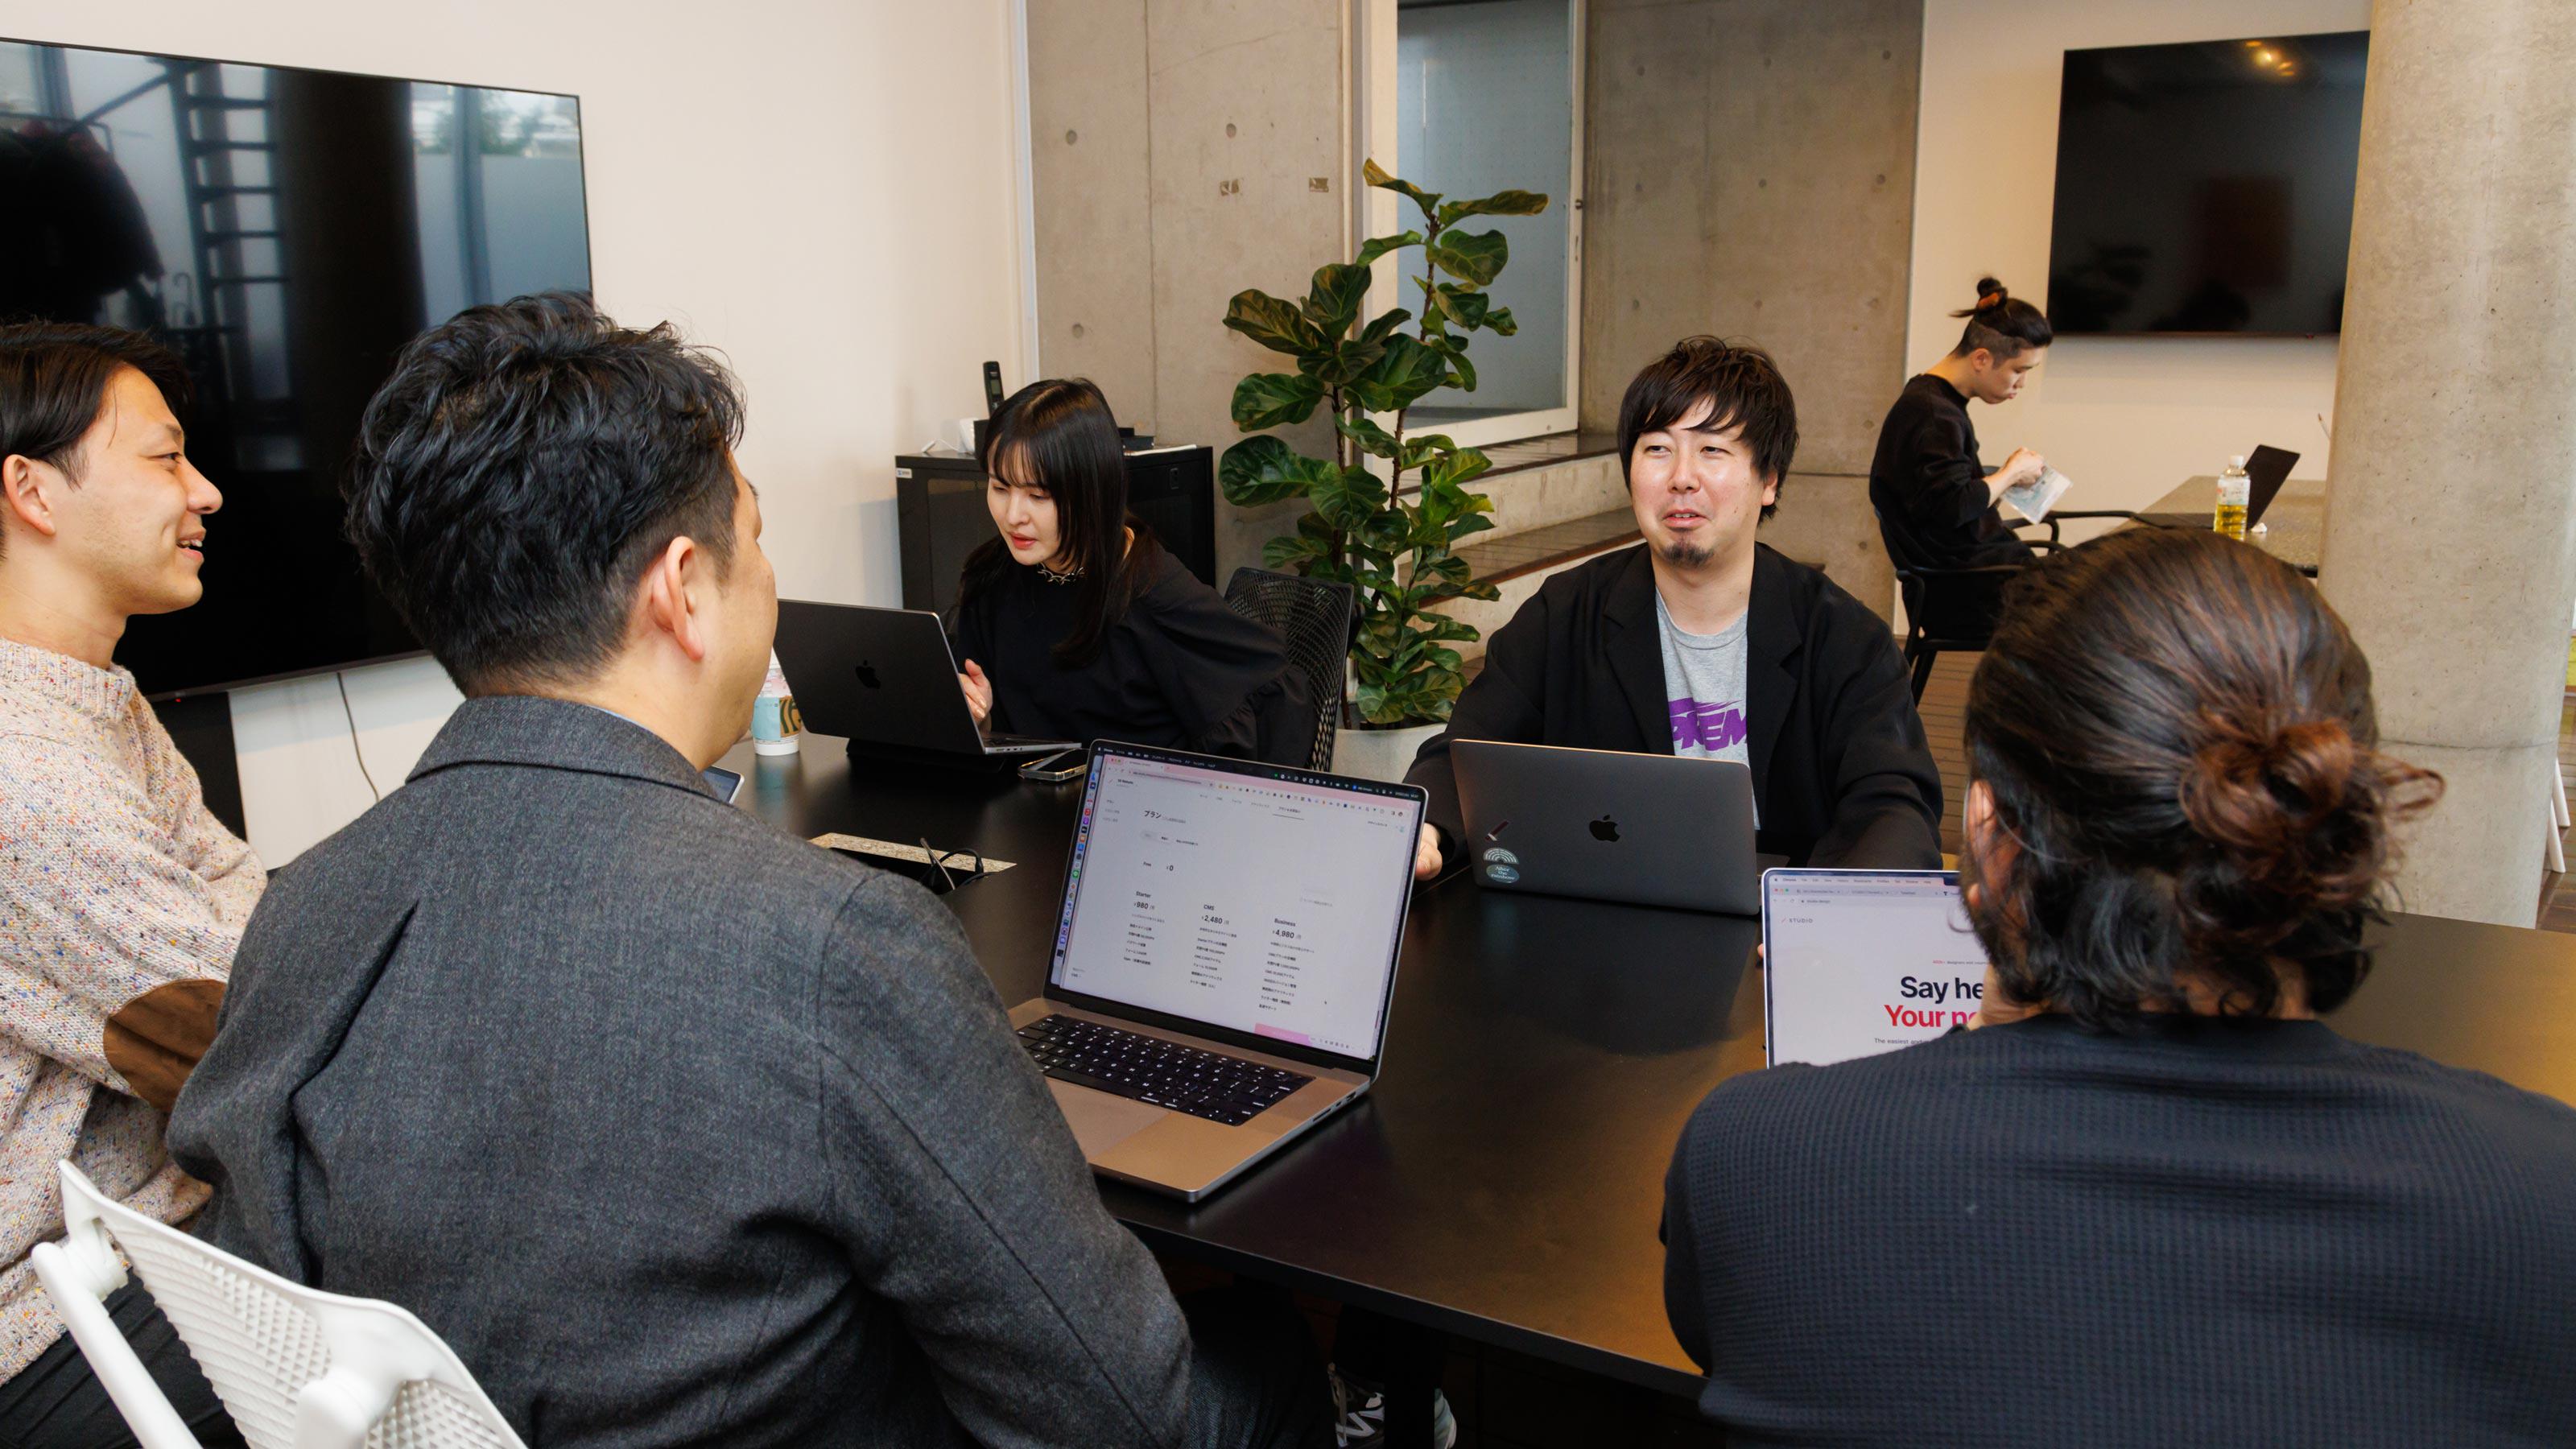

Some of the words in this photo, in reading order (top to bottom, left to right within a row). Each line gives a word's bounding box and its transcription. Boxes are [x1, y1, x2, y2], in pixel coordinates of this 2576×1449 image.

[1144, 810, 1162, 819] プラン
[1136, 890, 1151, 898] Starter
[1274, 918, 1296, 927] Business
[1901, 976, 1949, 1005] Say
[1884, 1004, 1946, 1027] Your
